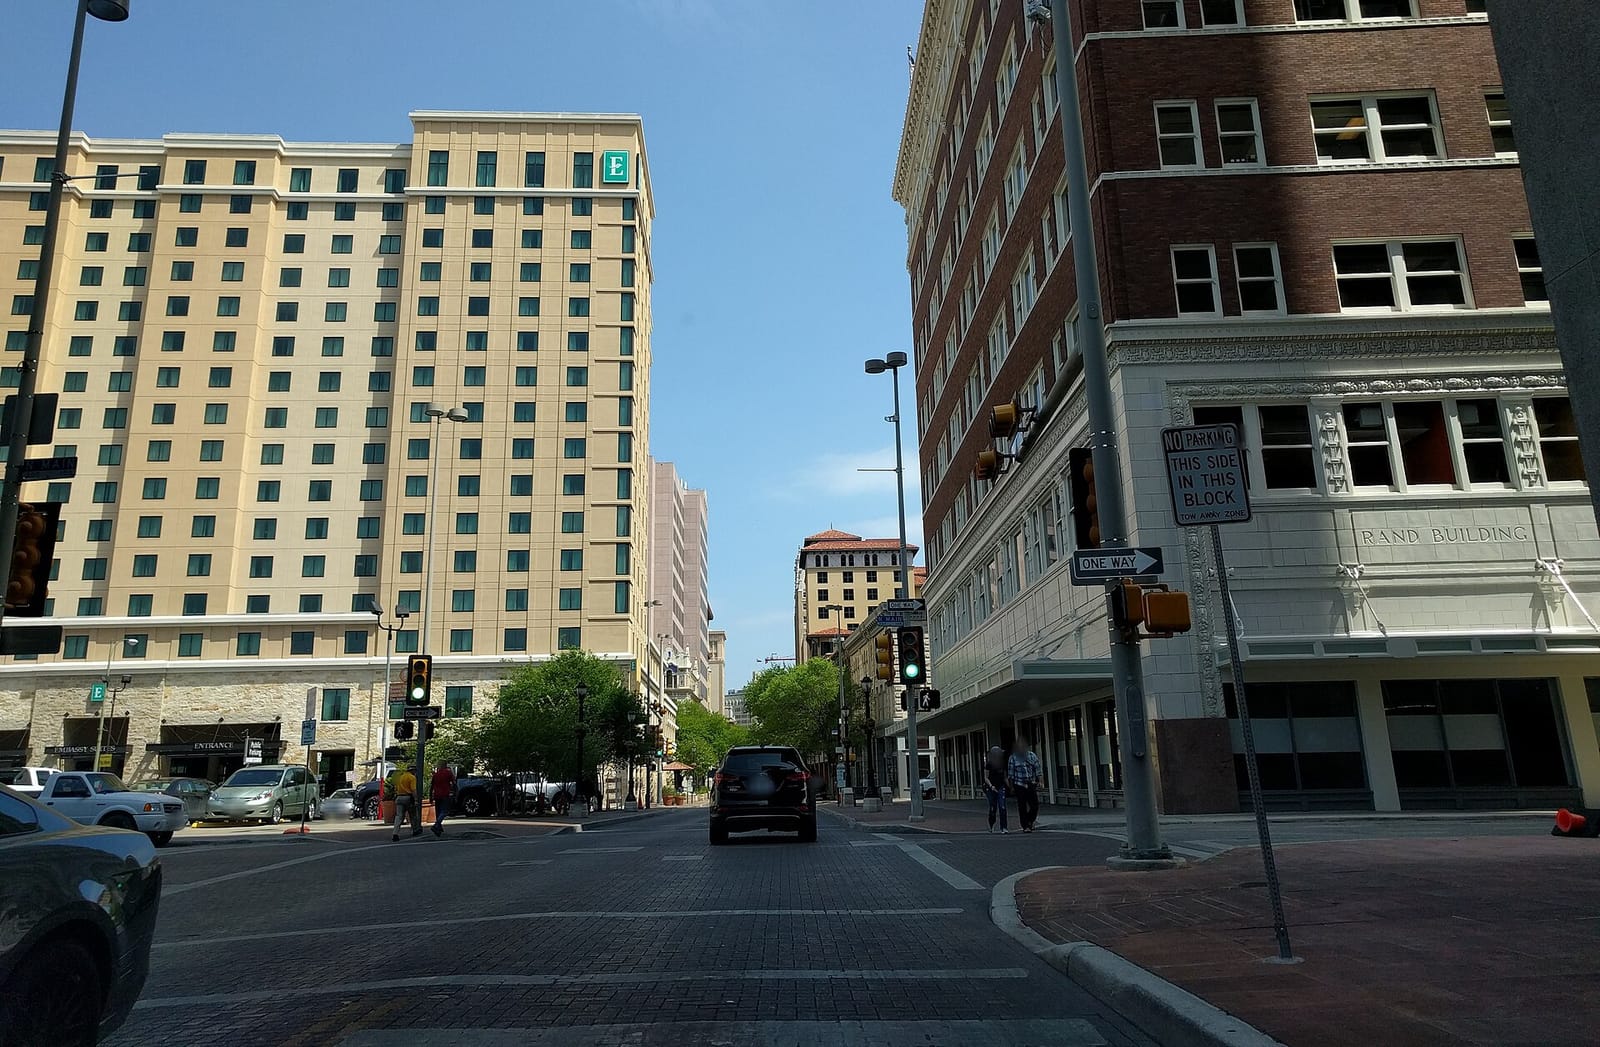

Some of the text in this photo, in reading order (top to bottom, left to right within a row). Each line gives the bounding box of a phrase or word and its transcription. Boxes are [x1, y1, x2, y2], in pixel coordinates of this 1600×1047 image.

[609, 156, 624, 176] E
[1163, 430, 1182, 451] NO
[1170, 454, 1238, 471] THIS SIDE
[1178, 472, 1236, 489] IN THIS
[1183, 490, 1236, 507] BLOCK
[1181, 509, 1246, 521] TOW AWAY ZONE
[1361, 526, 1528, 545] RAND BUILDING
[1082, 555, 1136, 569] ONE WAY
[95, 687, 102, 698] E
[194, 742, 234, 750] ENTRANCE
